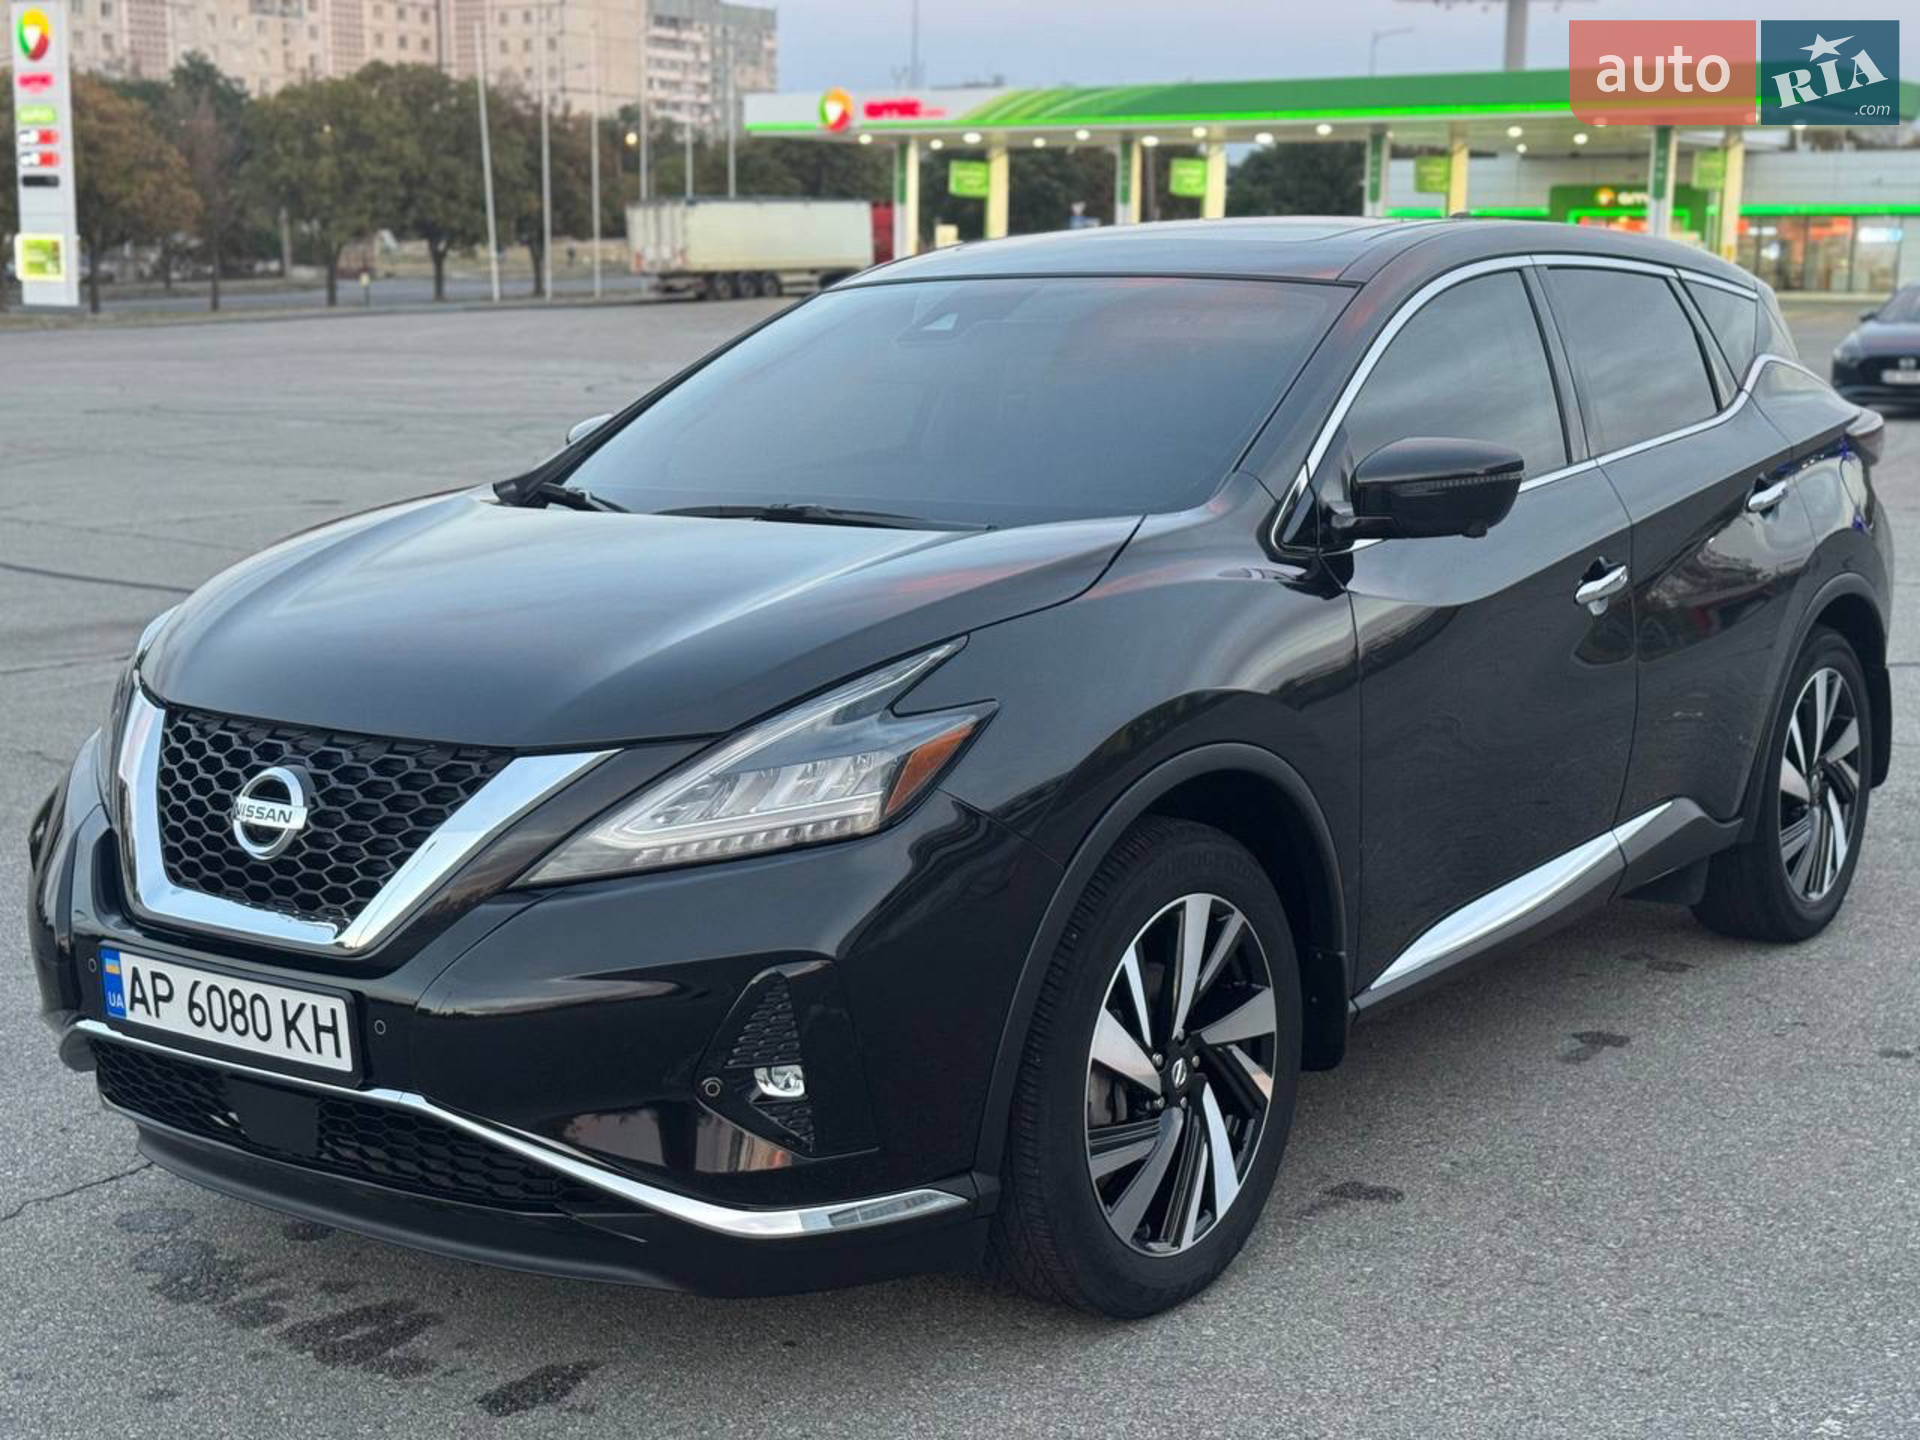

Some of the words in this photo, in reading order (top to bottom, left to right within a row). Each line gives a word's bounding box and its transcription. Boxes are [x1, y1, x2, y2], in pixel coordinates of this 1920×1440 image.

[236, 802, 293, 824] NISSAN
[108, 991, 124, 1008] UA
[129, 966, 175, 1018] AP
[187, 980, 273, 1042] 6080
[281, 999, 342, 1058] KH
